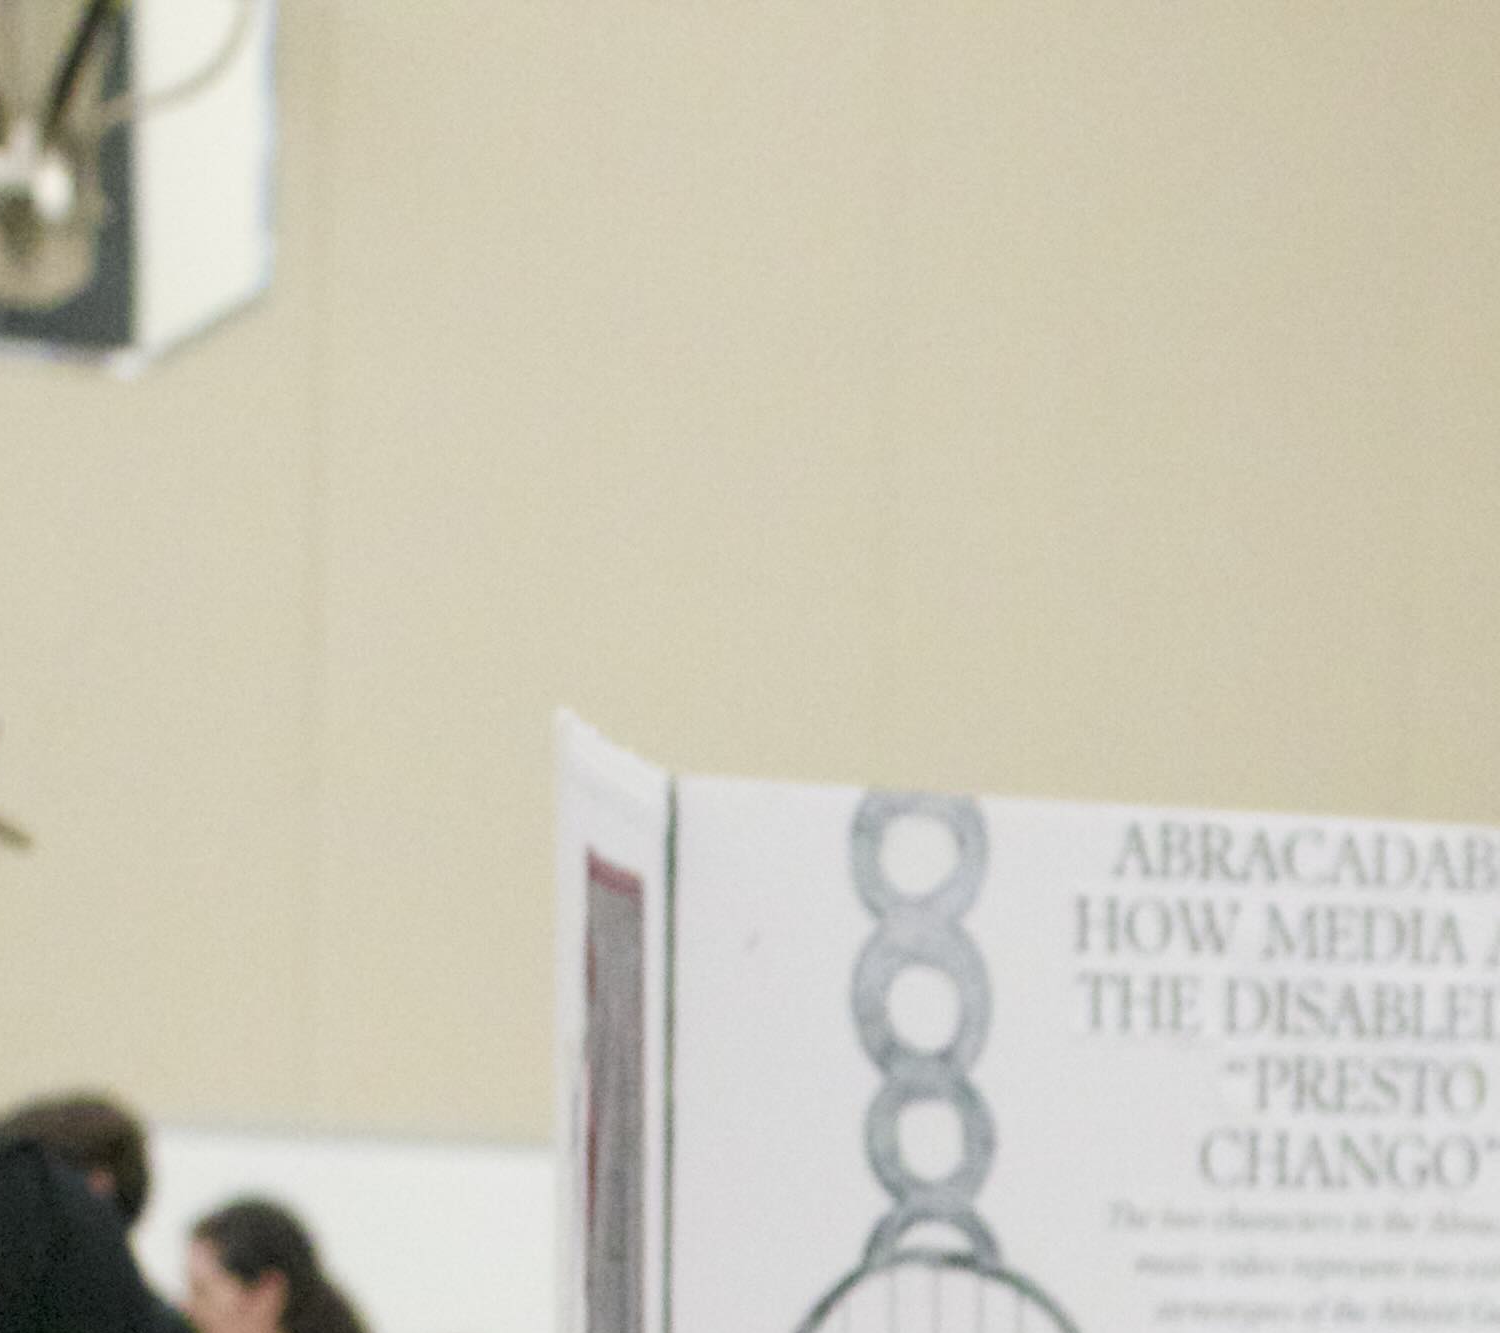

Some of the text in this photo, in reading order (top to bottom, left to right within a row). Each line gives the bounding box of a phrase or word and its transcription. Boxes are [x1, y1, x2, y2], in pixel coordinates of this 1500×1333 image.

[1073, 894, 1242, 956] HOW
[1260, 902, 1467, 968] MEDIA
[1075, 970, 1202, 1034] THE
